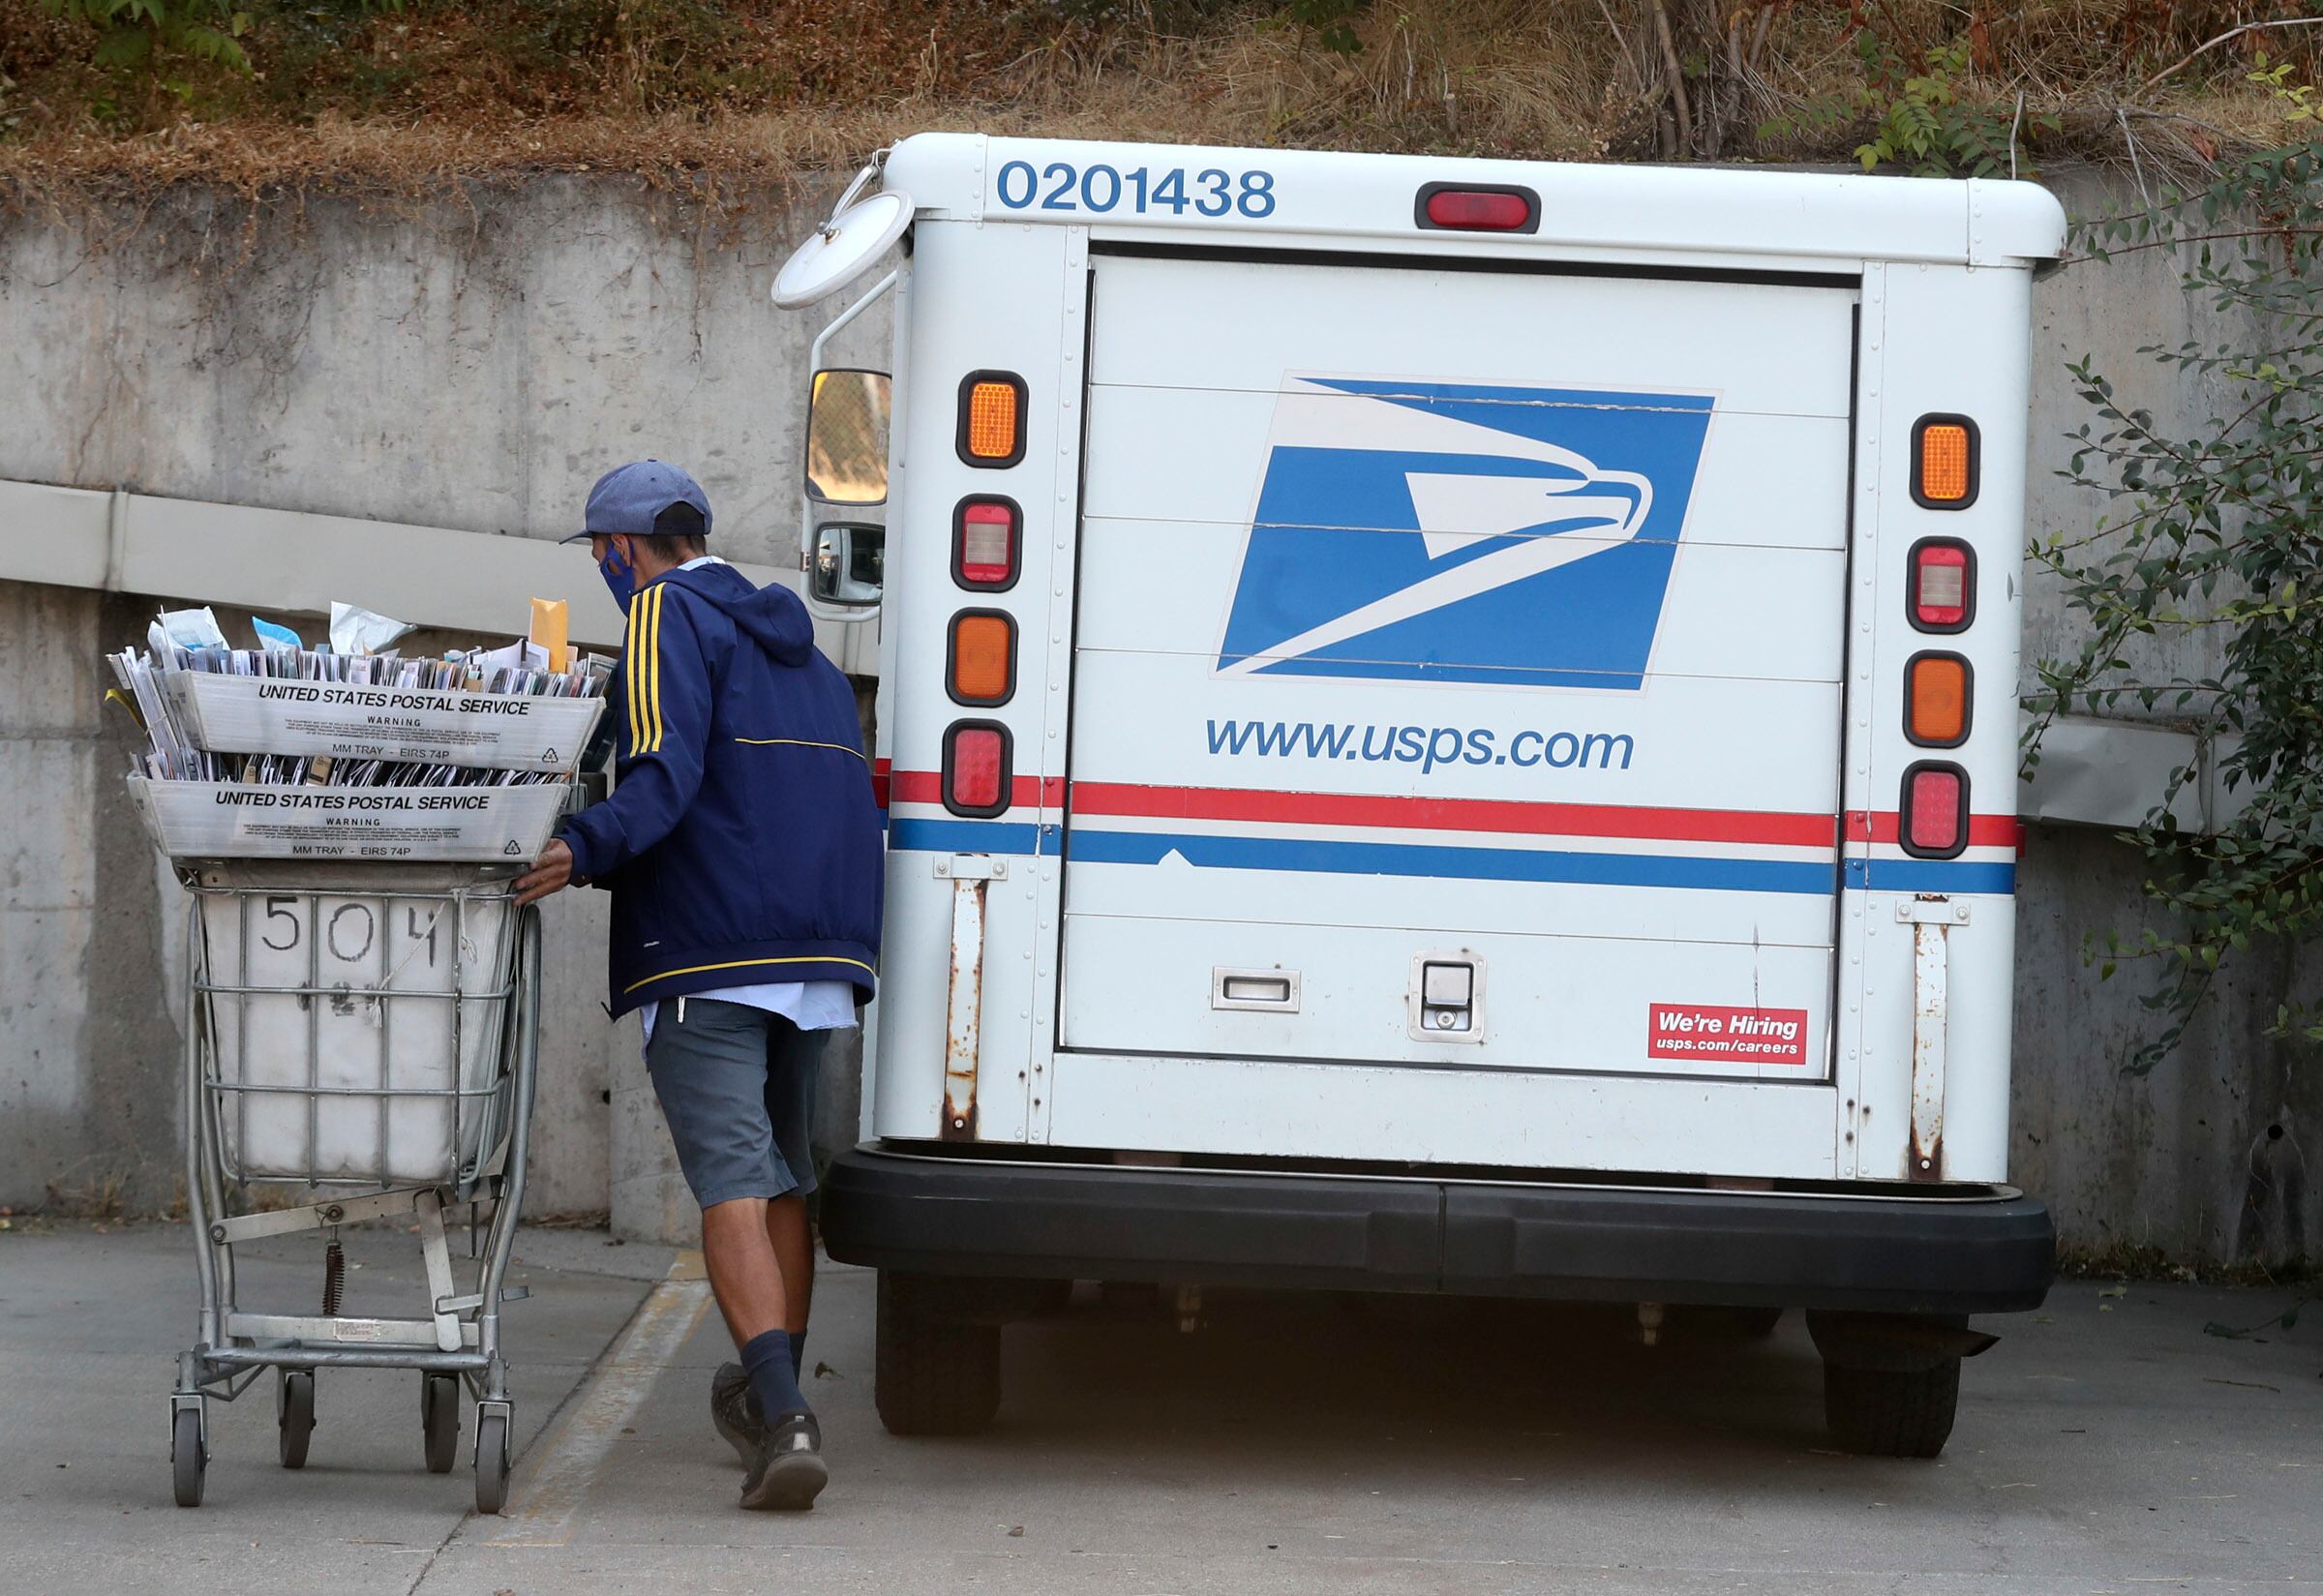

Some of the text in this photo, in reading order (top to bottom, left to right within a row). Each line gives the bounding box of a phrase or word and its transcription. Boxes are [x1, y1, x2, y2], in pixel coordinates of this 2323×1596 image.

[997, 160, 1276, 218] 0201438
[258, 684, 530, 715] UNITED STATES POSTAL SERVICE
[367, 715, 421, 727] WARNING
[332, 743, 351, 754] MM
[353, 744, 384, 756] TRAY
[400, 747, 427, 759] EIRS
[430, 749, 449, 760] 74P
[1206, 719, 1634, 774] www.usps.com
[216, 791, 490, 809] UNITED STATES POSTAL SERVICE
[325, 817, 380, 827] WARNING
[292, 845, 313, 855] MM
[315, 846, 345, 855] TRAY
[361, 846, 387, 856] EIRS
[390, 846, 411, 856] 74P
[1658, 1011, 1798, 1040] We're Hiring
[1656, 1038, 1797, 1054] usps.com/careers
